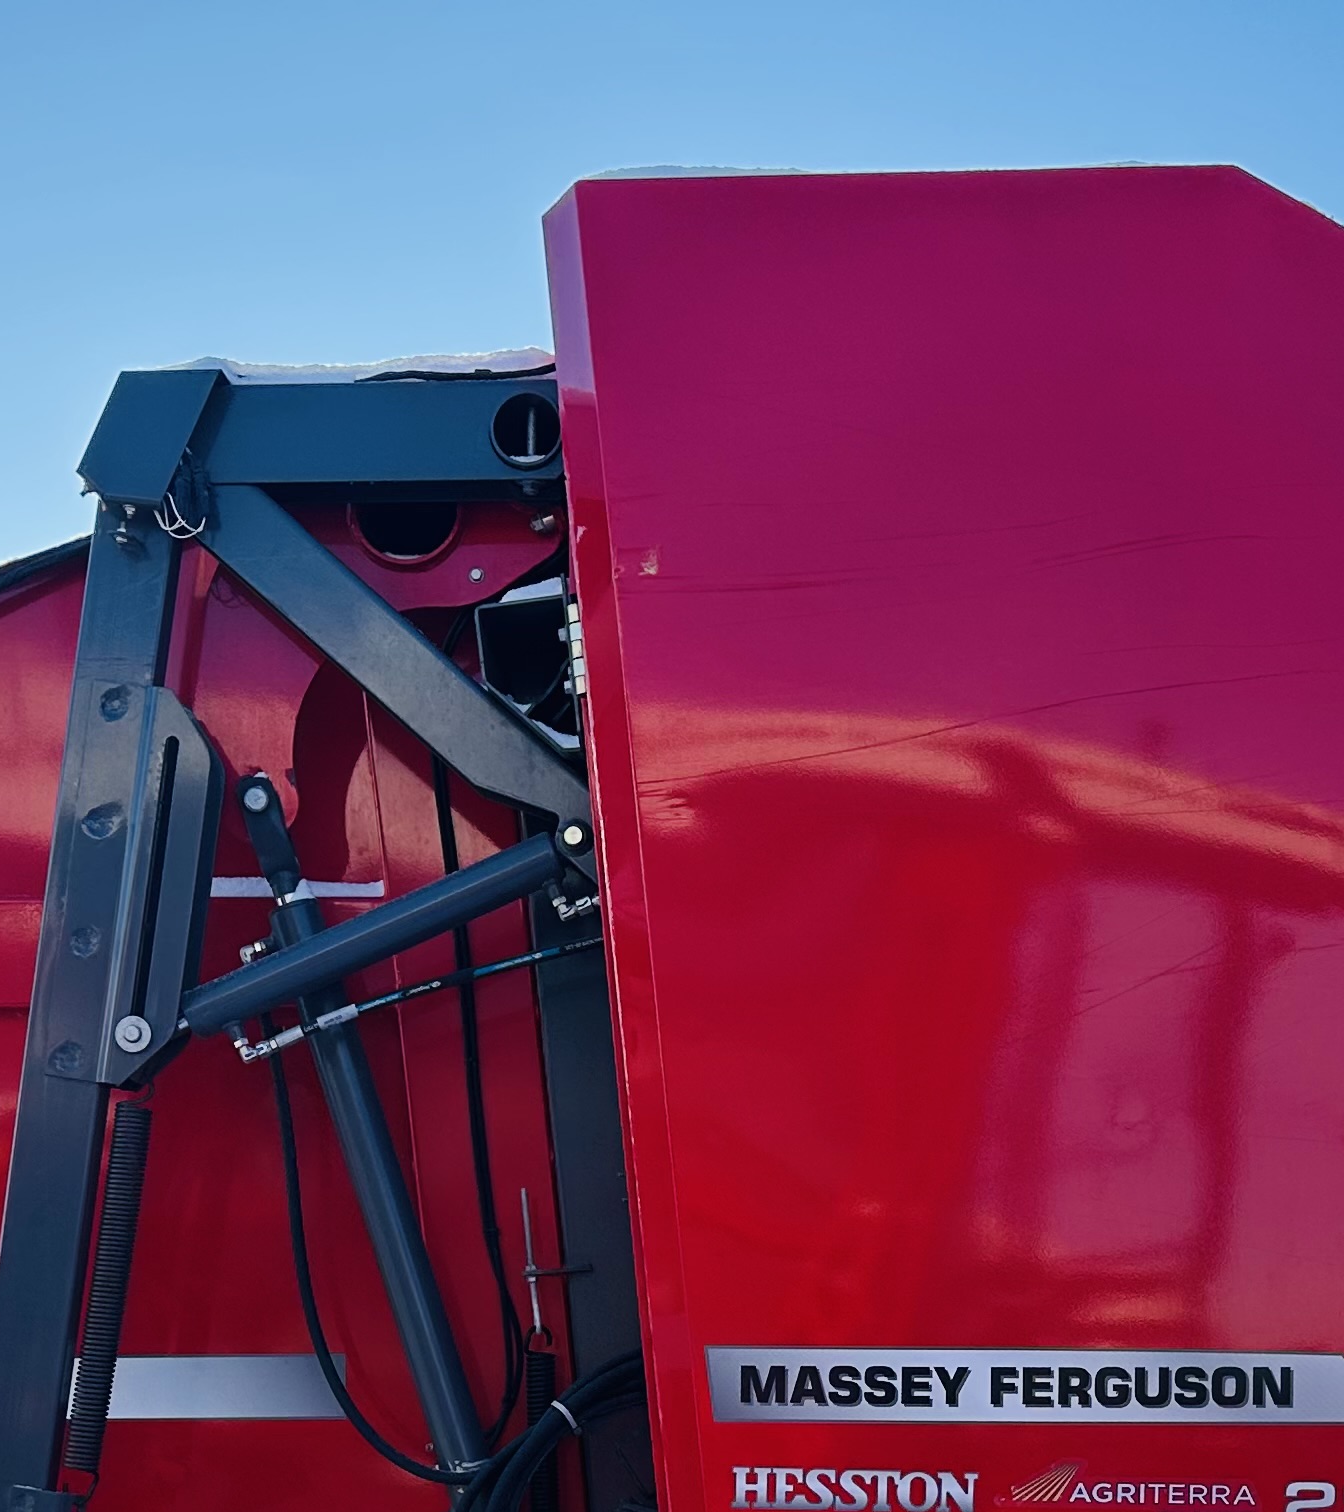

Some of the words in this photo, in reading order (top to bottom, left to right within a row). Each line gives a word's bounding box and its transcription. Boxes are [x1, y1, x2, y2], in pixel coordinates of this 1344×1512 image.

[740, 1365, 970, 1407] MASSEY
[990, 1366, 1294, 1408] FERGUSON
[1069, 1482, 1256, 1506] AGRITERRA
